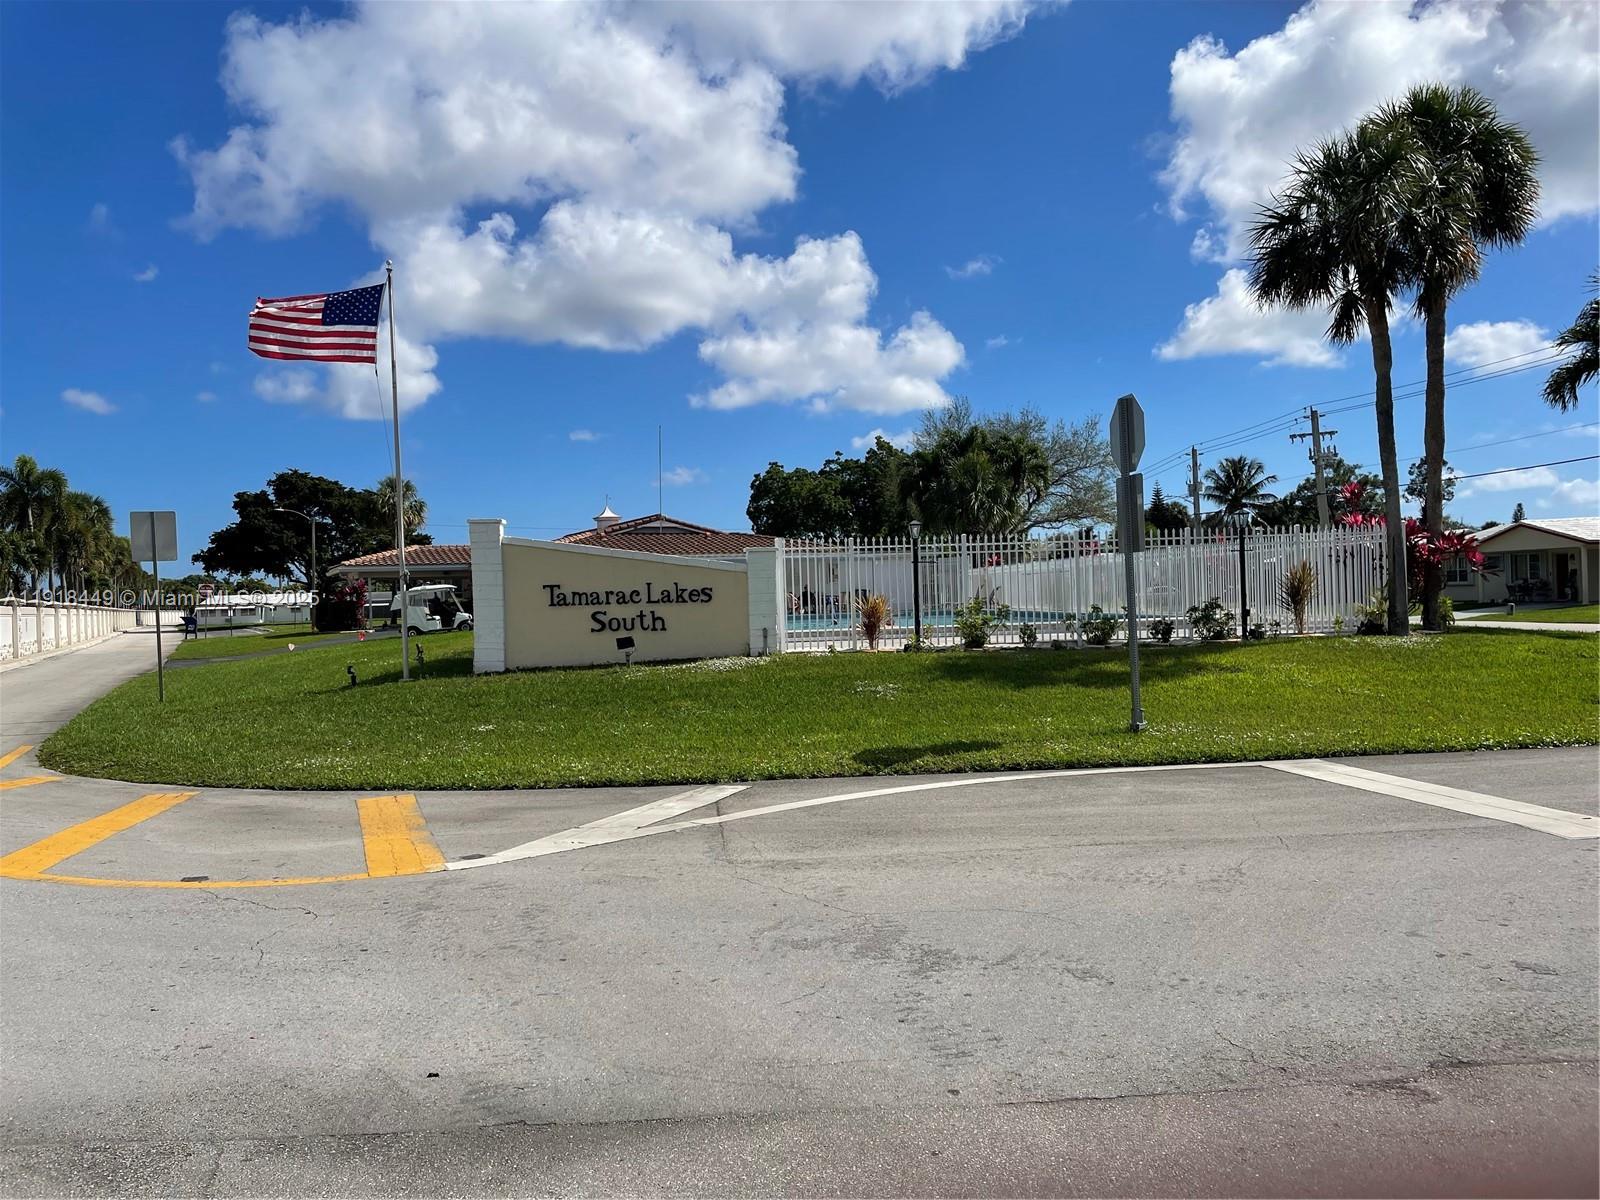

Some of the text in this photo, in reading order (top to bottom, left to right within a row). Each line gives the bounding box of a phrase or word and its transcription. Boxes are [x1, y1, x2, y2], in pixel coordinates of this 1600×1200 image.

[542, 582, 713, 607] Tamarac Lakes
[590, 610, 667, 633] South
